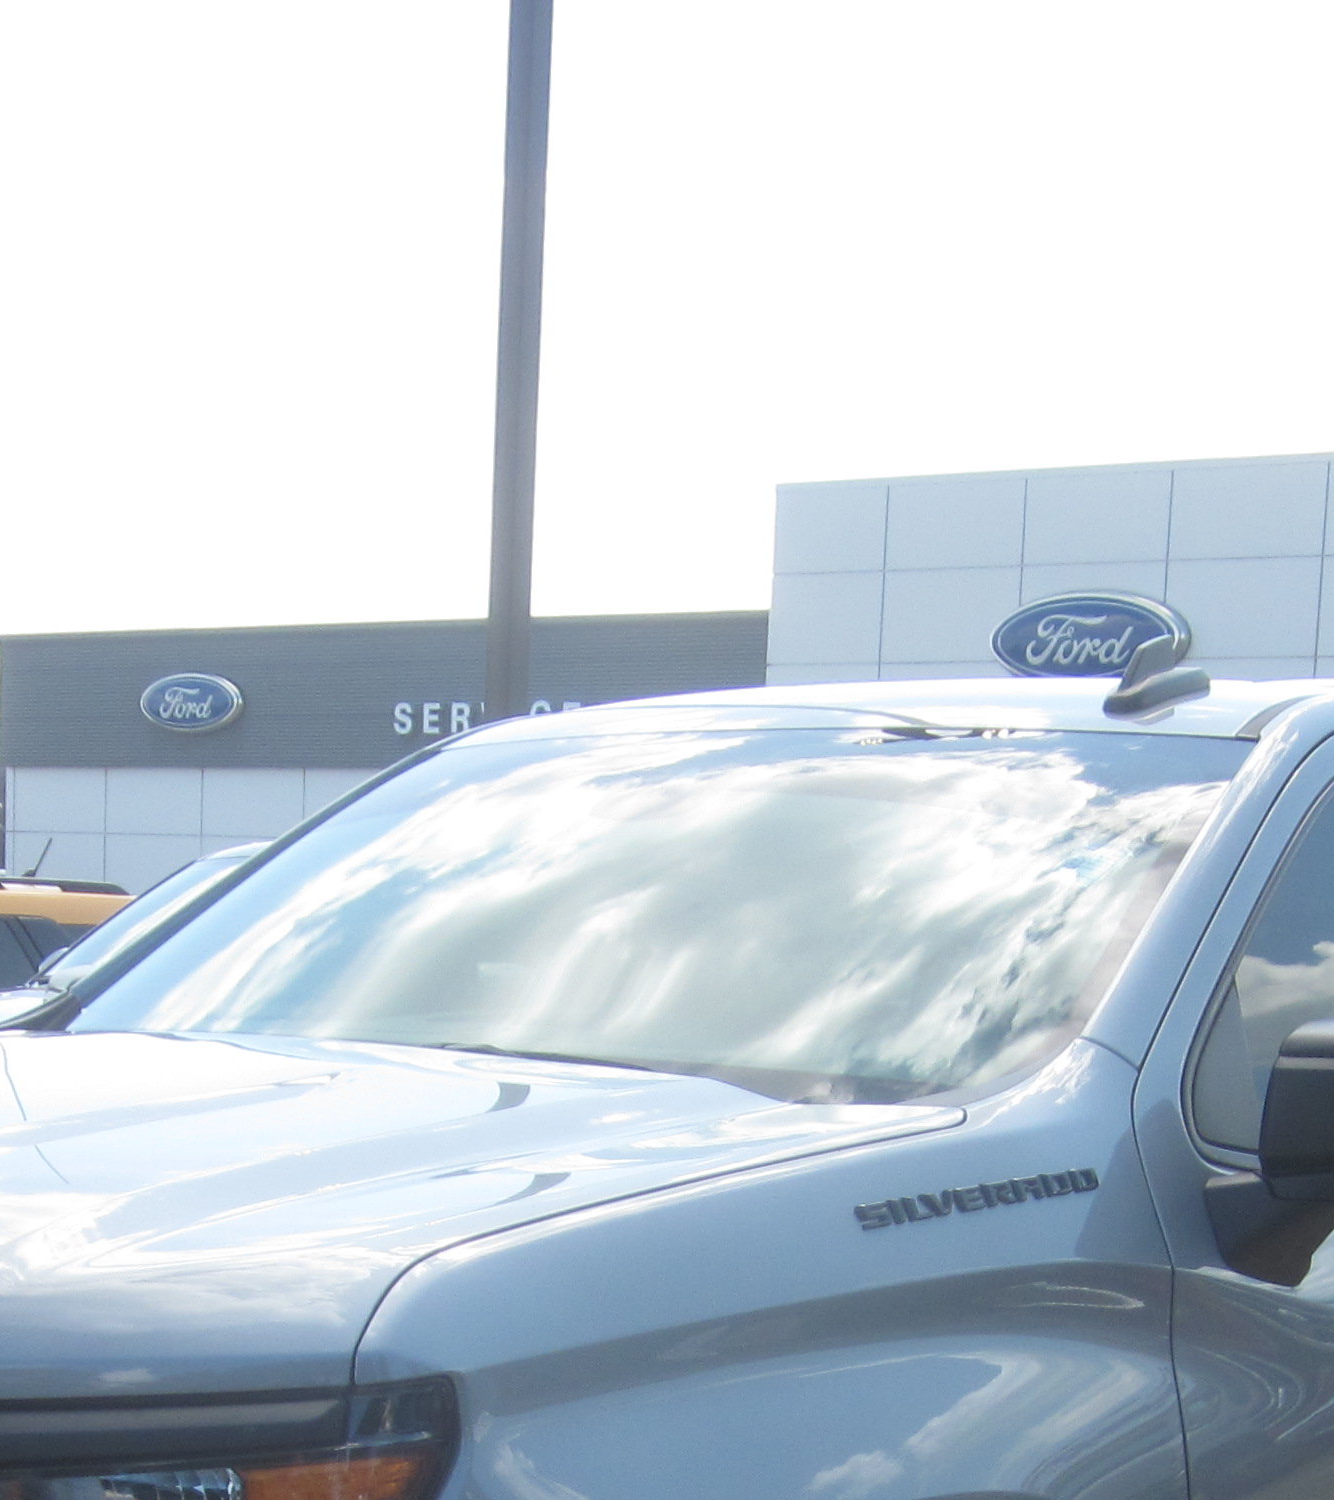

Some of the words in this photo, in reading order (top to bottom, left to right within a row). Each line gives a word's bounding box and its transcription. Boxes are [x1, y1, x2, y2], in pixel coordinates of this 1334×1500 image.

[1026, 614, 1133, 666] Ford
[159, 686, 213, 719] Ford
[854, 1167, 1099, 1230] SILVERADO
